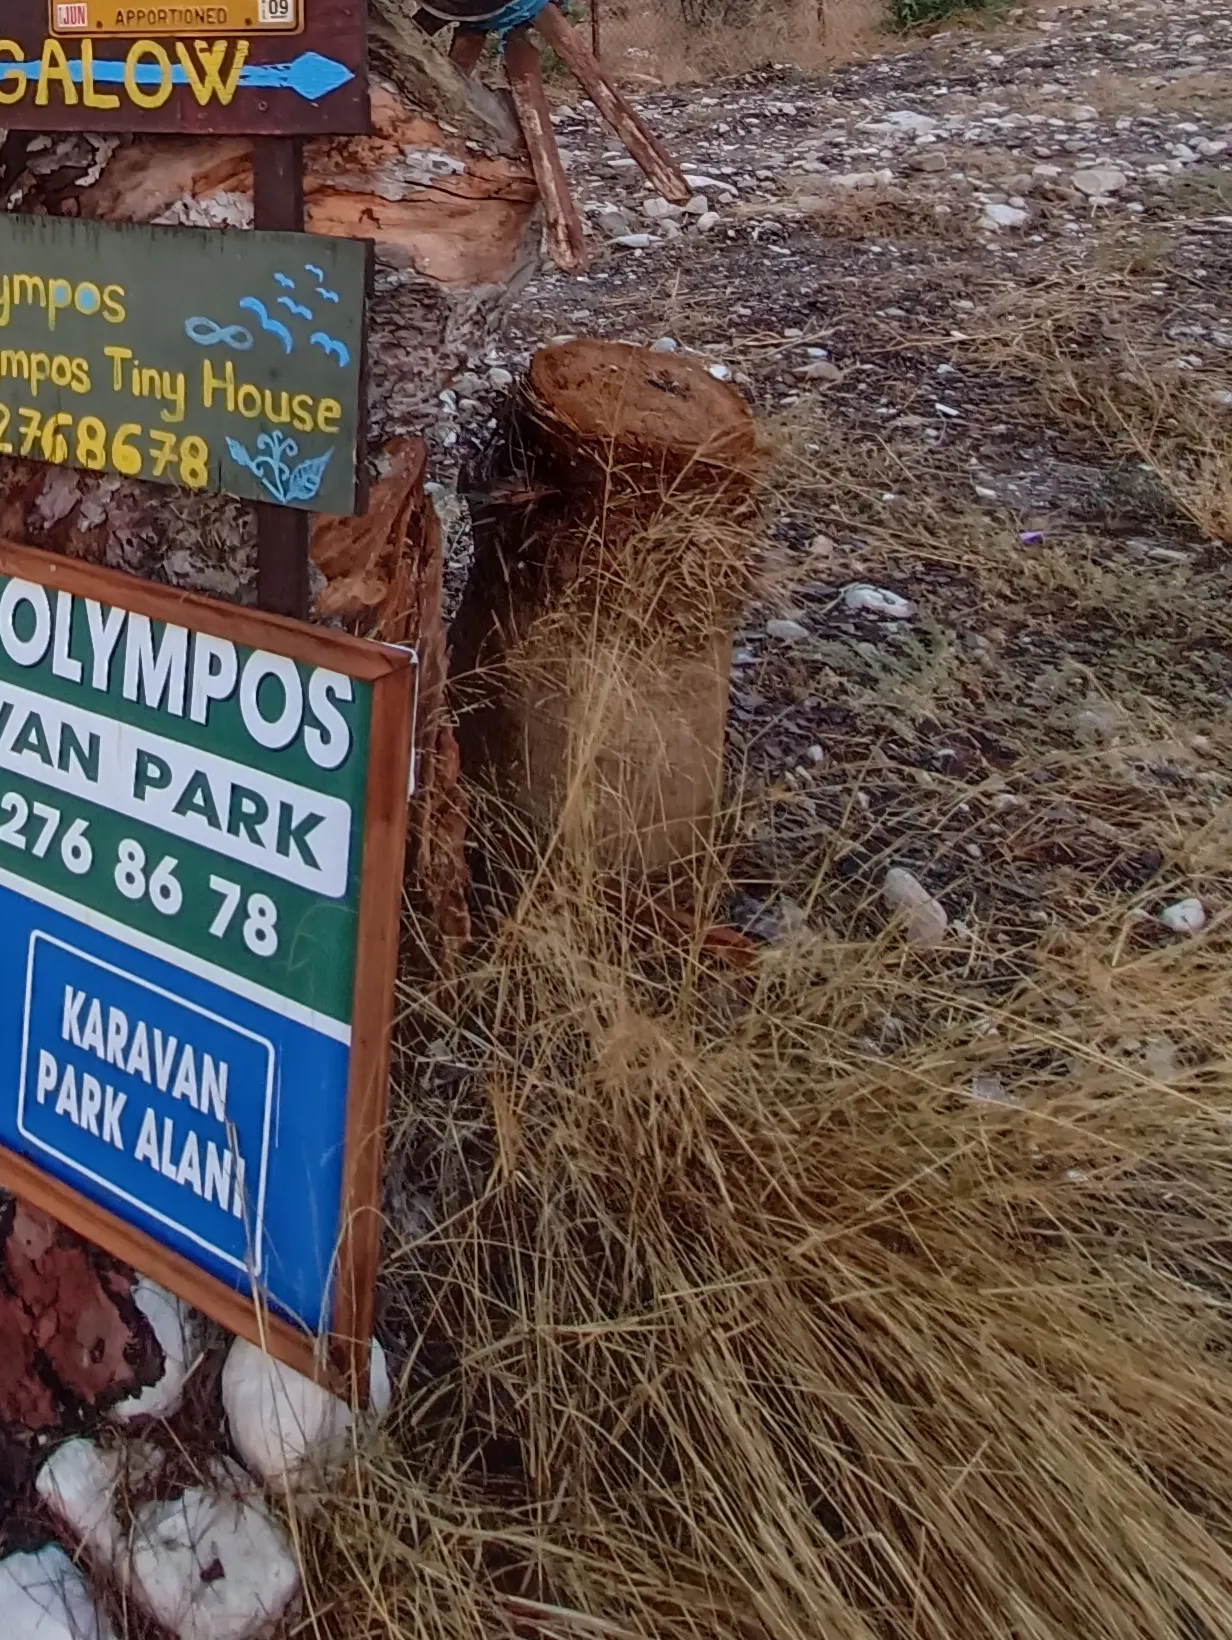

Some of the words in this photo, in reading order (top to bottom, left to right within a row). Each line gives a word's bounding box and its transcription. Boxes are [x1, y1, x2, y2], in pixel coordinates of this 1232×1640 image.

[63, 5, 86, 25] JUN
[115, 7, 228, 26] APPORTIONED
[103, 346, 185, 422] Tiny
[202, 359, 343, 434] House
[0, 577, 353, 770] OLYMPOS
[0, 792, 94, 874] 276
[114, 838, 183, 916] 86
[208, 875, 279, 958] 78
[132, 747, 328, 872] PARK
[62, 984, 229, 1123] KARAVAN
[36, 1048, 128, 1150] PARK
[134, 1107, 246, 1219] ALANI
